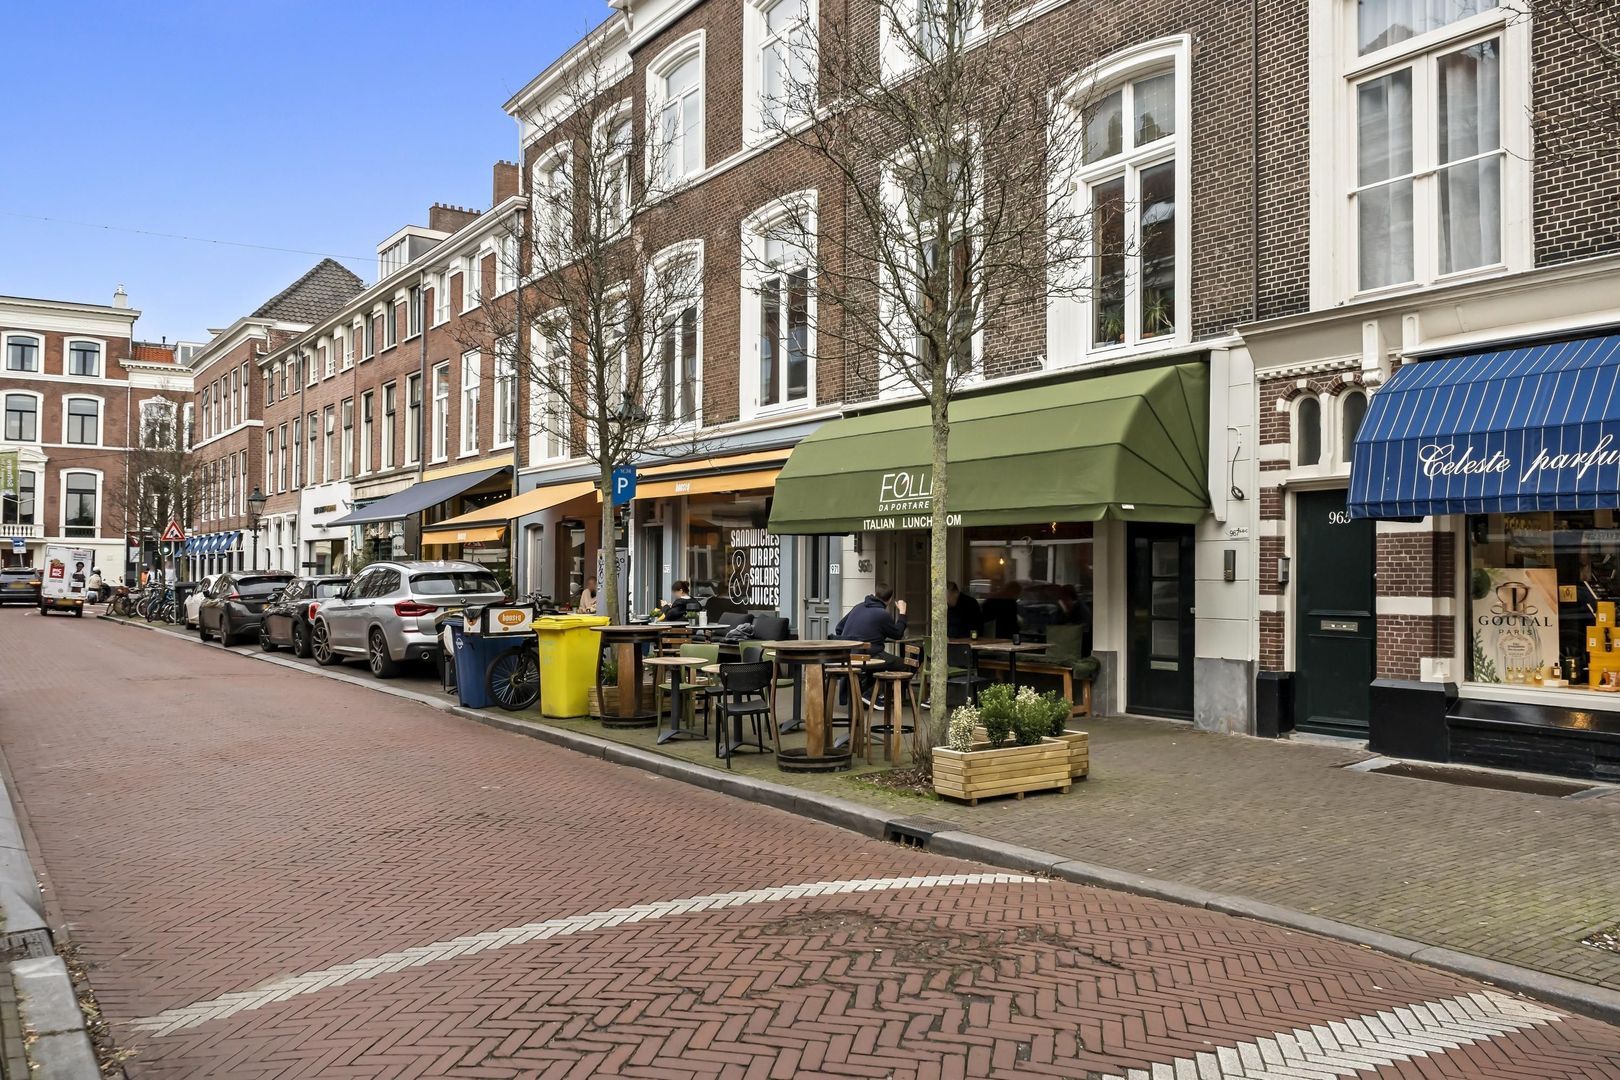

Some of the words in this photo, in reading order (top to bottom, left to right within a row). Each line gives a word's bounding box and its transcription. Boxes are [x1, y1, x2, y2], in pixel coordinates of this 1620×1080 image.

[1419, 444, 1510, 480] Celeste
[617, 477, 629, 494] P
[878, 504, 889, 512] DA
[890, 501, 930, 511] PORTARE
[863, 518, 895, 530] ITALIAN
[902, 514, 962, 528] LUNCHOM
[730, 528, 780, 547] SANDWICHES
[750, 548, 780, 566] WRAPS
[728, 549, 750, 605] &
[749, 567, 780, 586] SALADS
[749, 586, 780, 606] JUICES
[1478, 615, 1553, 627] GOUTAL
